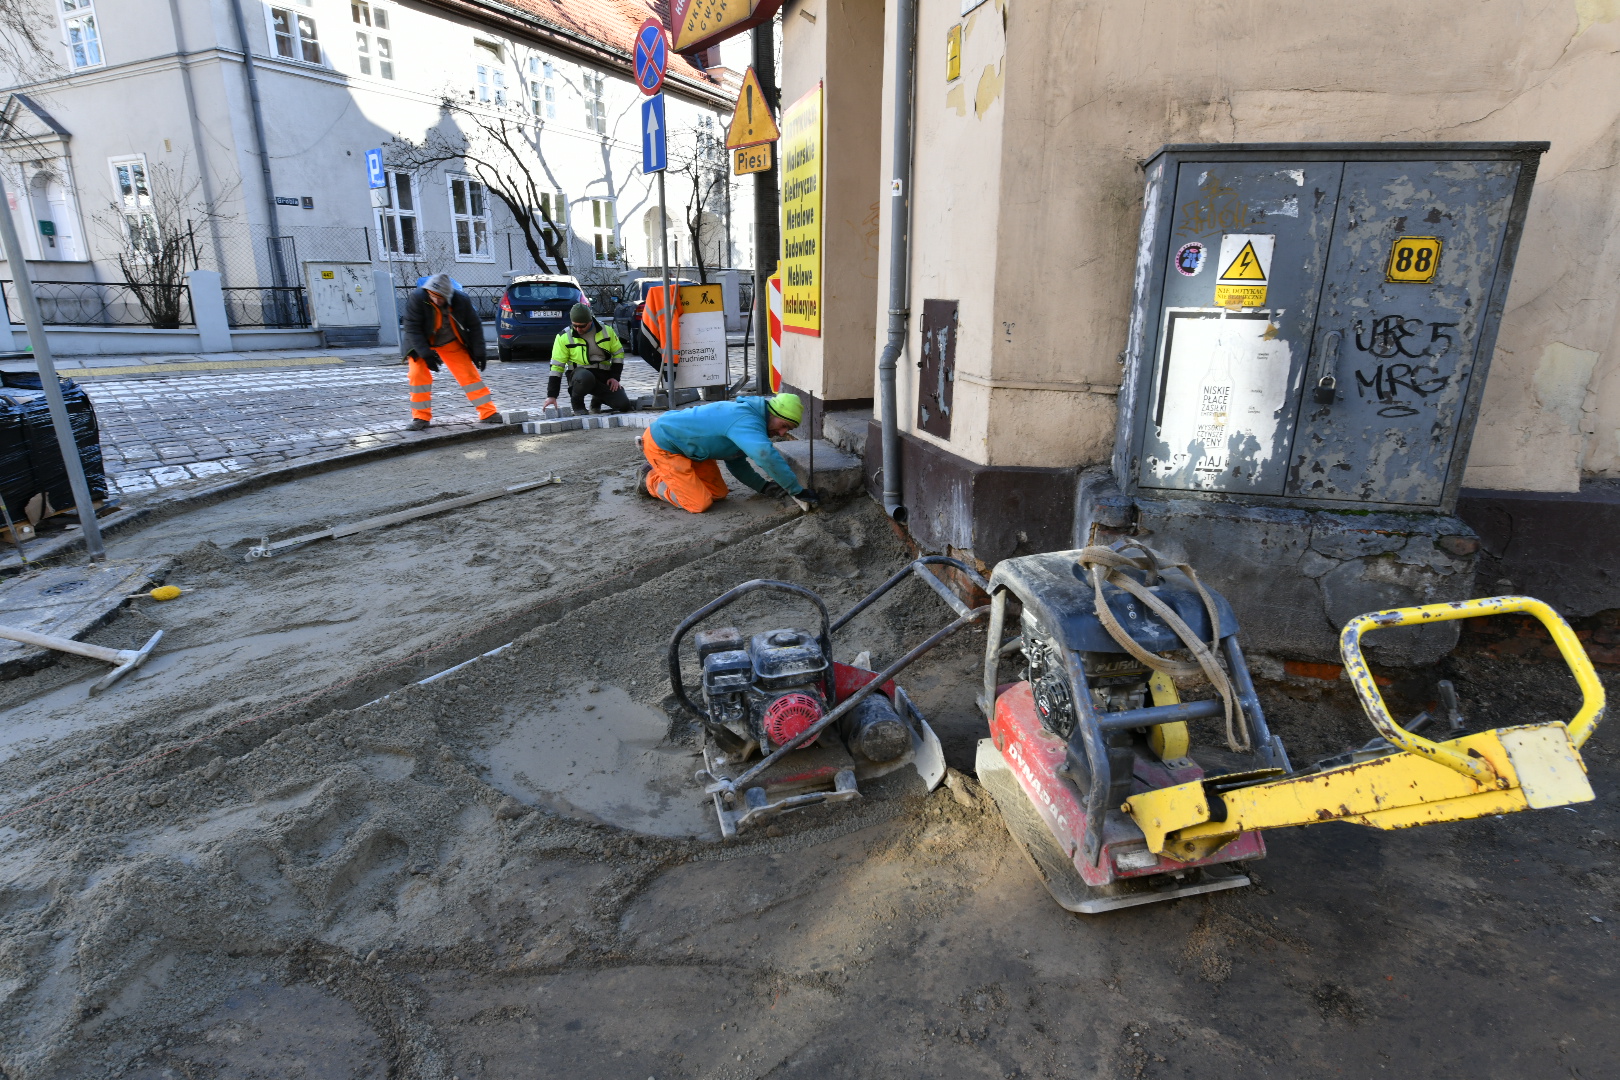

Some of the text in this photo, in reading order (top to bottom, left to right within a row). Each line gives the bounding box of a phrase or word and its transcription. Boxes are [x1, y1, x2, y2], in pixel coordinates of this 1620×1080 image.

[738, 149, 767, 171] Piesi
[786, 136, 815, 173] Malarskie
[368, 154, 380, 183] P
[784, 173, 817, 203] Elektryczne
[787, 204, 815, 231] Metalowe
[785, 235, 816, 260] Budowlane
[1395, 247, 1433, 272] 88
[788, 264, 813, 287] Meblowe
[1232, 287, 1265, 295] DOTYKAĆ
[783, 293, 817, 321] Instalacyjne
[1203, 386, 1230, 395] NISKIE
[1203, 395, 1228, 404] PŁACE
[1201, 404, 1227, 412] ZASIŁKI
[1196, 430, 1223, 438] CZYNSZE
[1197, 424, 1225, 432] WYSOKIE
[1008, 743, 1068, 832] DYNAPAC
